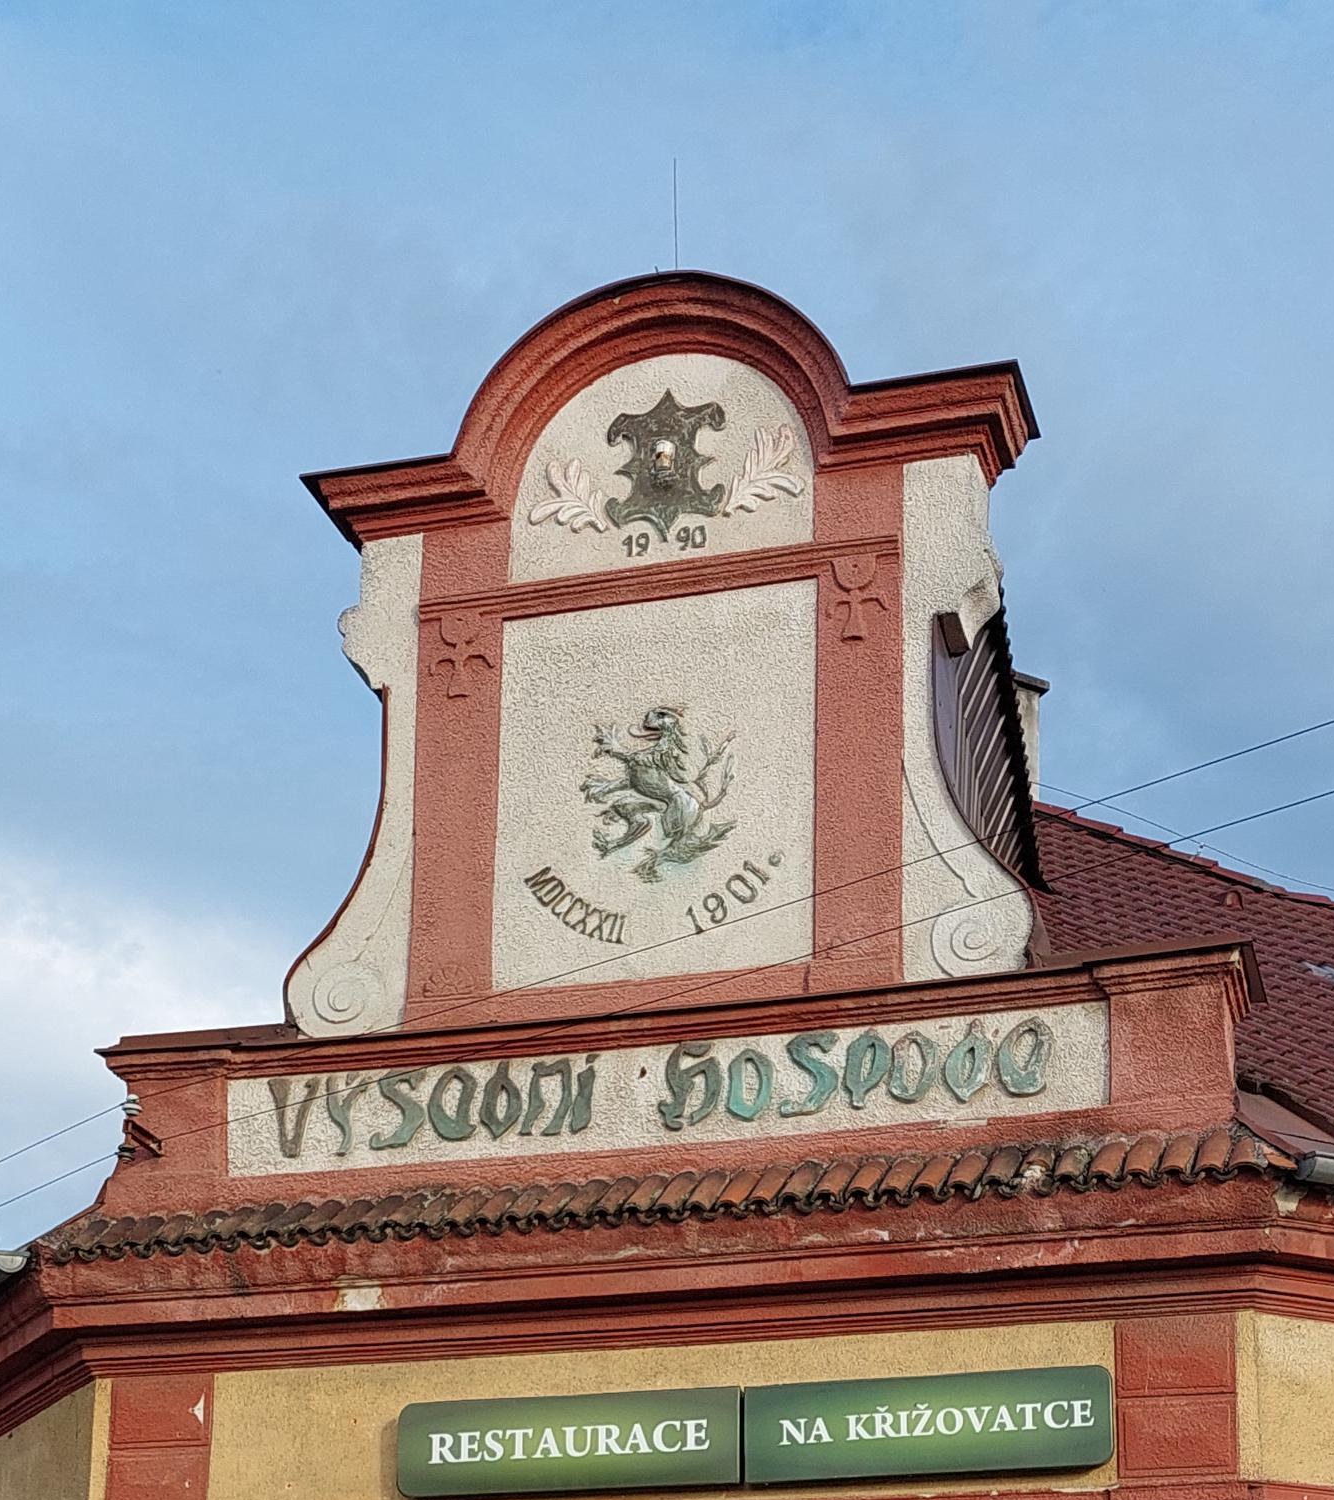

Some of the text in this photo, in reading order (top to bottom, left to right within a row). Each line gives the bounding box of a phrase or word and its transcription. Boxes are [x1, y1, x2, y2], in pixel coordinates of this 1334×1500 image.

[623, 525, 707, 558] 19 90
[523, 866, 626, 945] MDCCXXII
[428, 1399, 1095, 1464] RESTAURACE NA KŘIŽOVATCE
